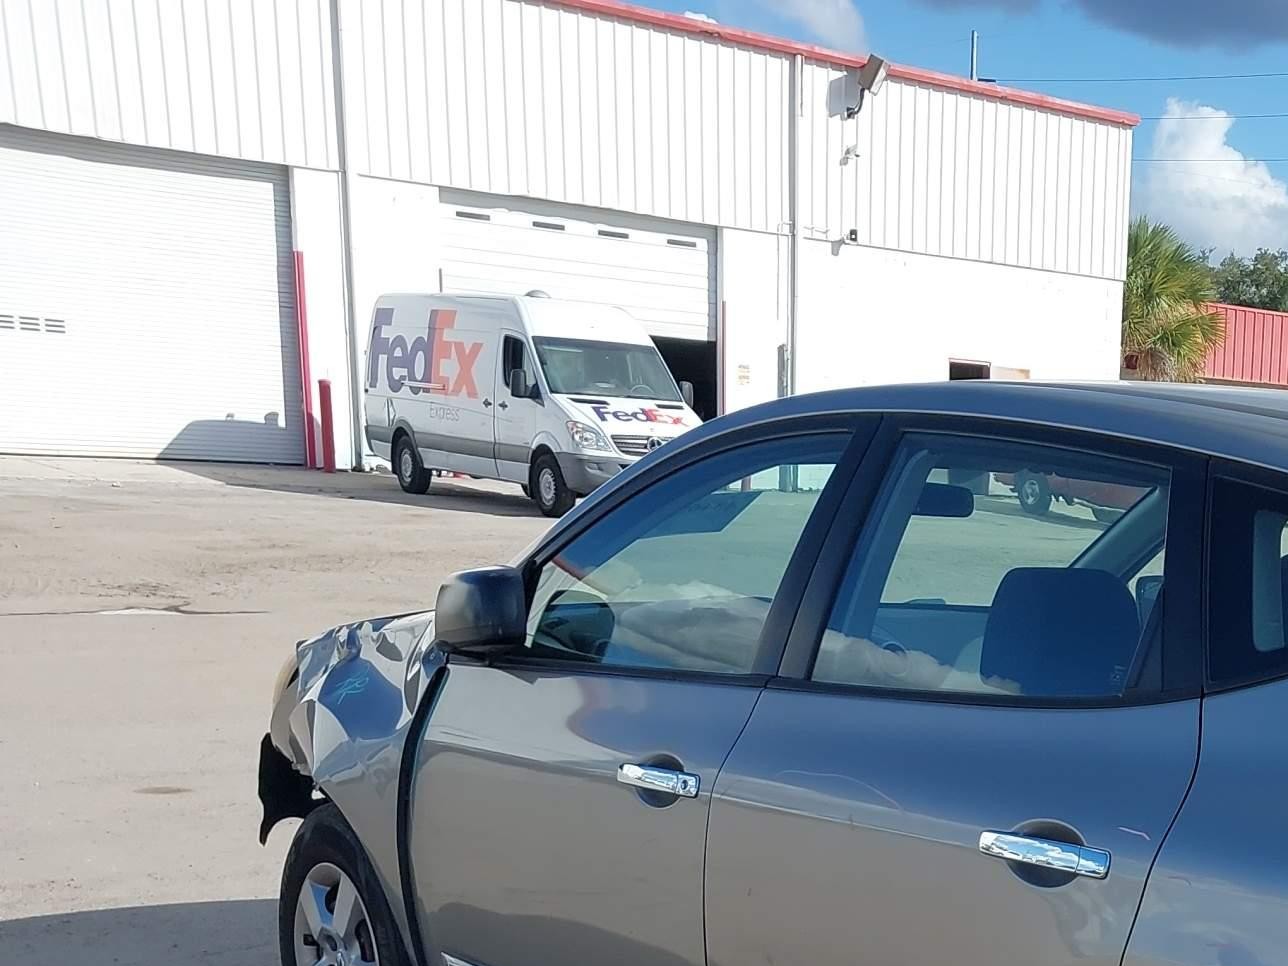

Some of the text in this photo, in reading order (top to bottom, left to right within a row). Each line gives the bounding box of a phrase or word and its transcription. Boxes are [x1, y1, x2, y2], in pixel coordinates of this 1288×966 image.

[369, 308, 484, 399] FedEx
[429, 404, 461, 422] Express
[591, 405, 689, 427] FedEx
